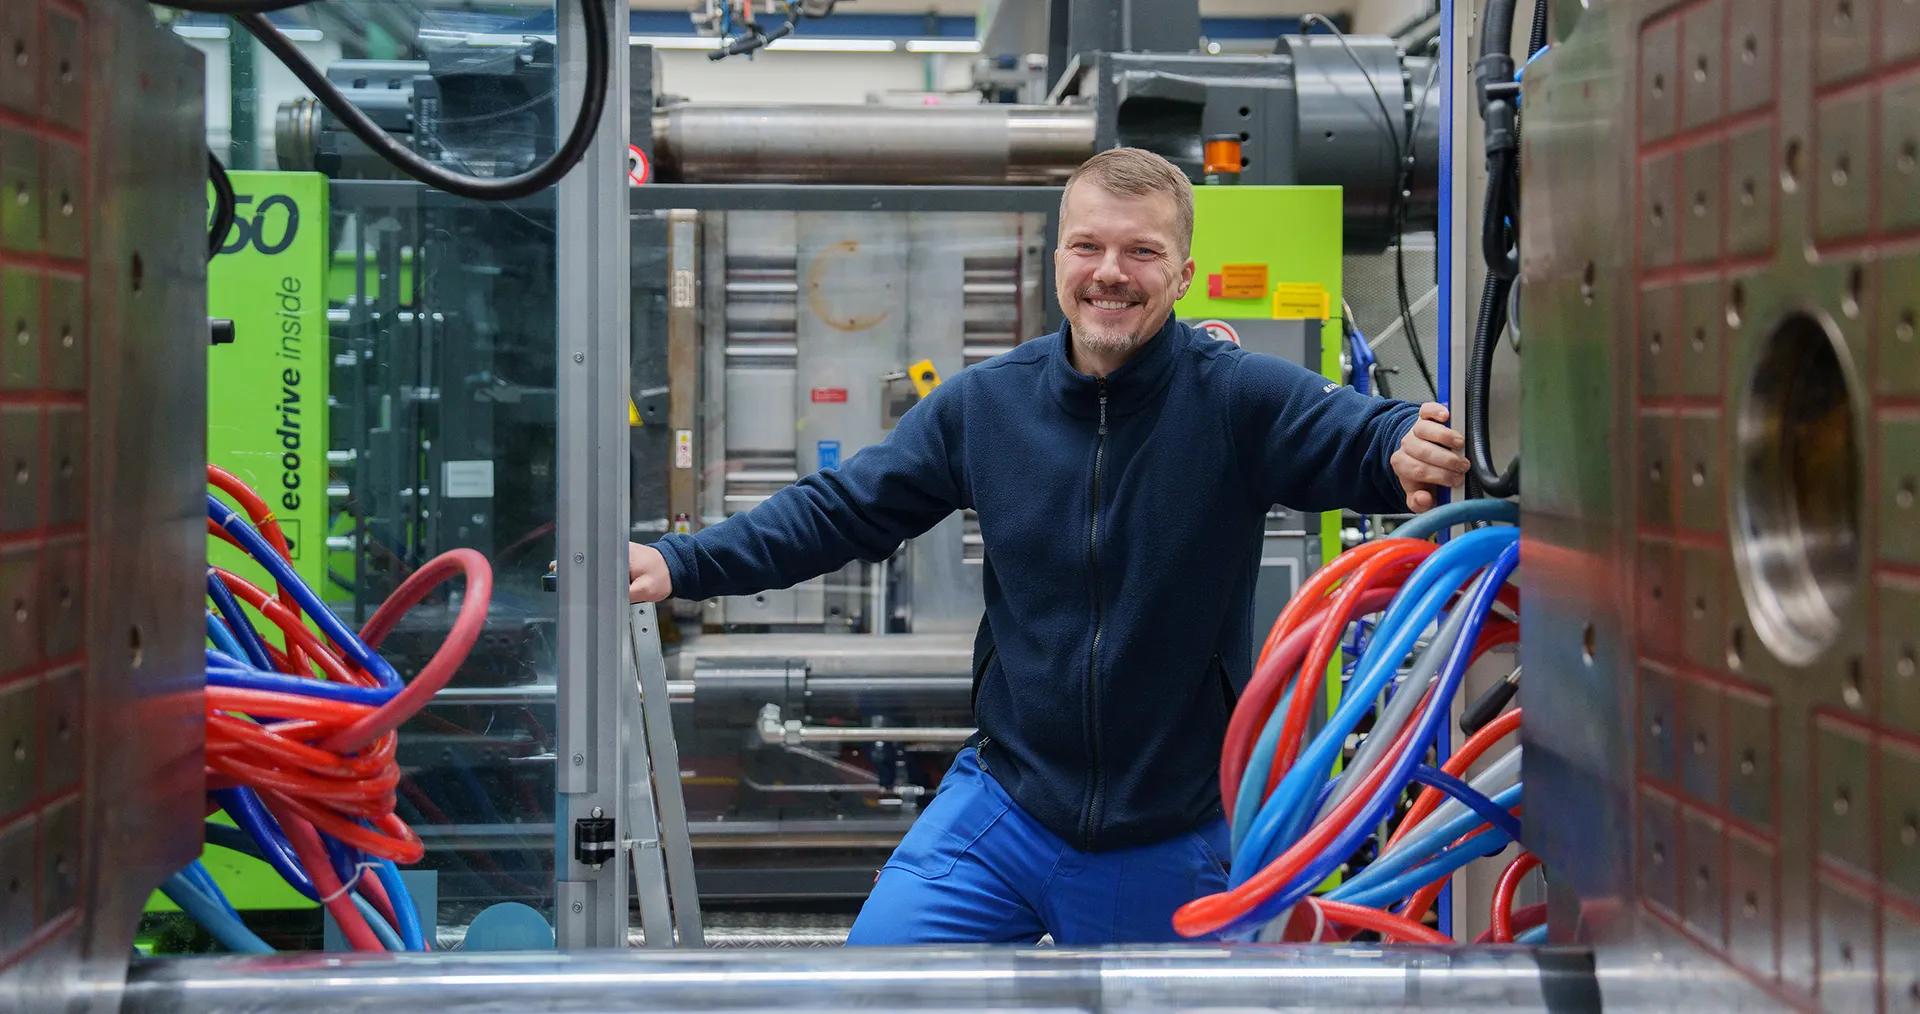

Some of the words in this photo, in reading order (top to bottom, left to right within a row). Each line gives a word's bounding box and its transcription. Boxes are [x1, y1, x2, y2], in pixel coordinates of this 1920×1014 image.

[207, 195, 299, 255] 50
[276, 276, 301, 360] inside
[276, 368, 301, 510] ecodrive
